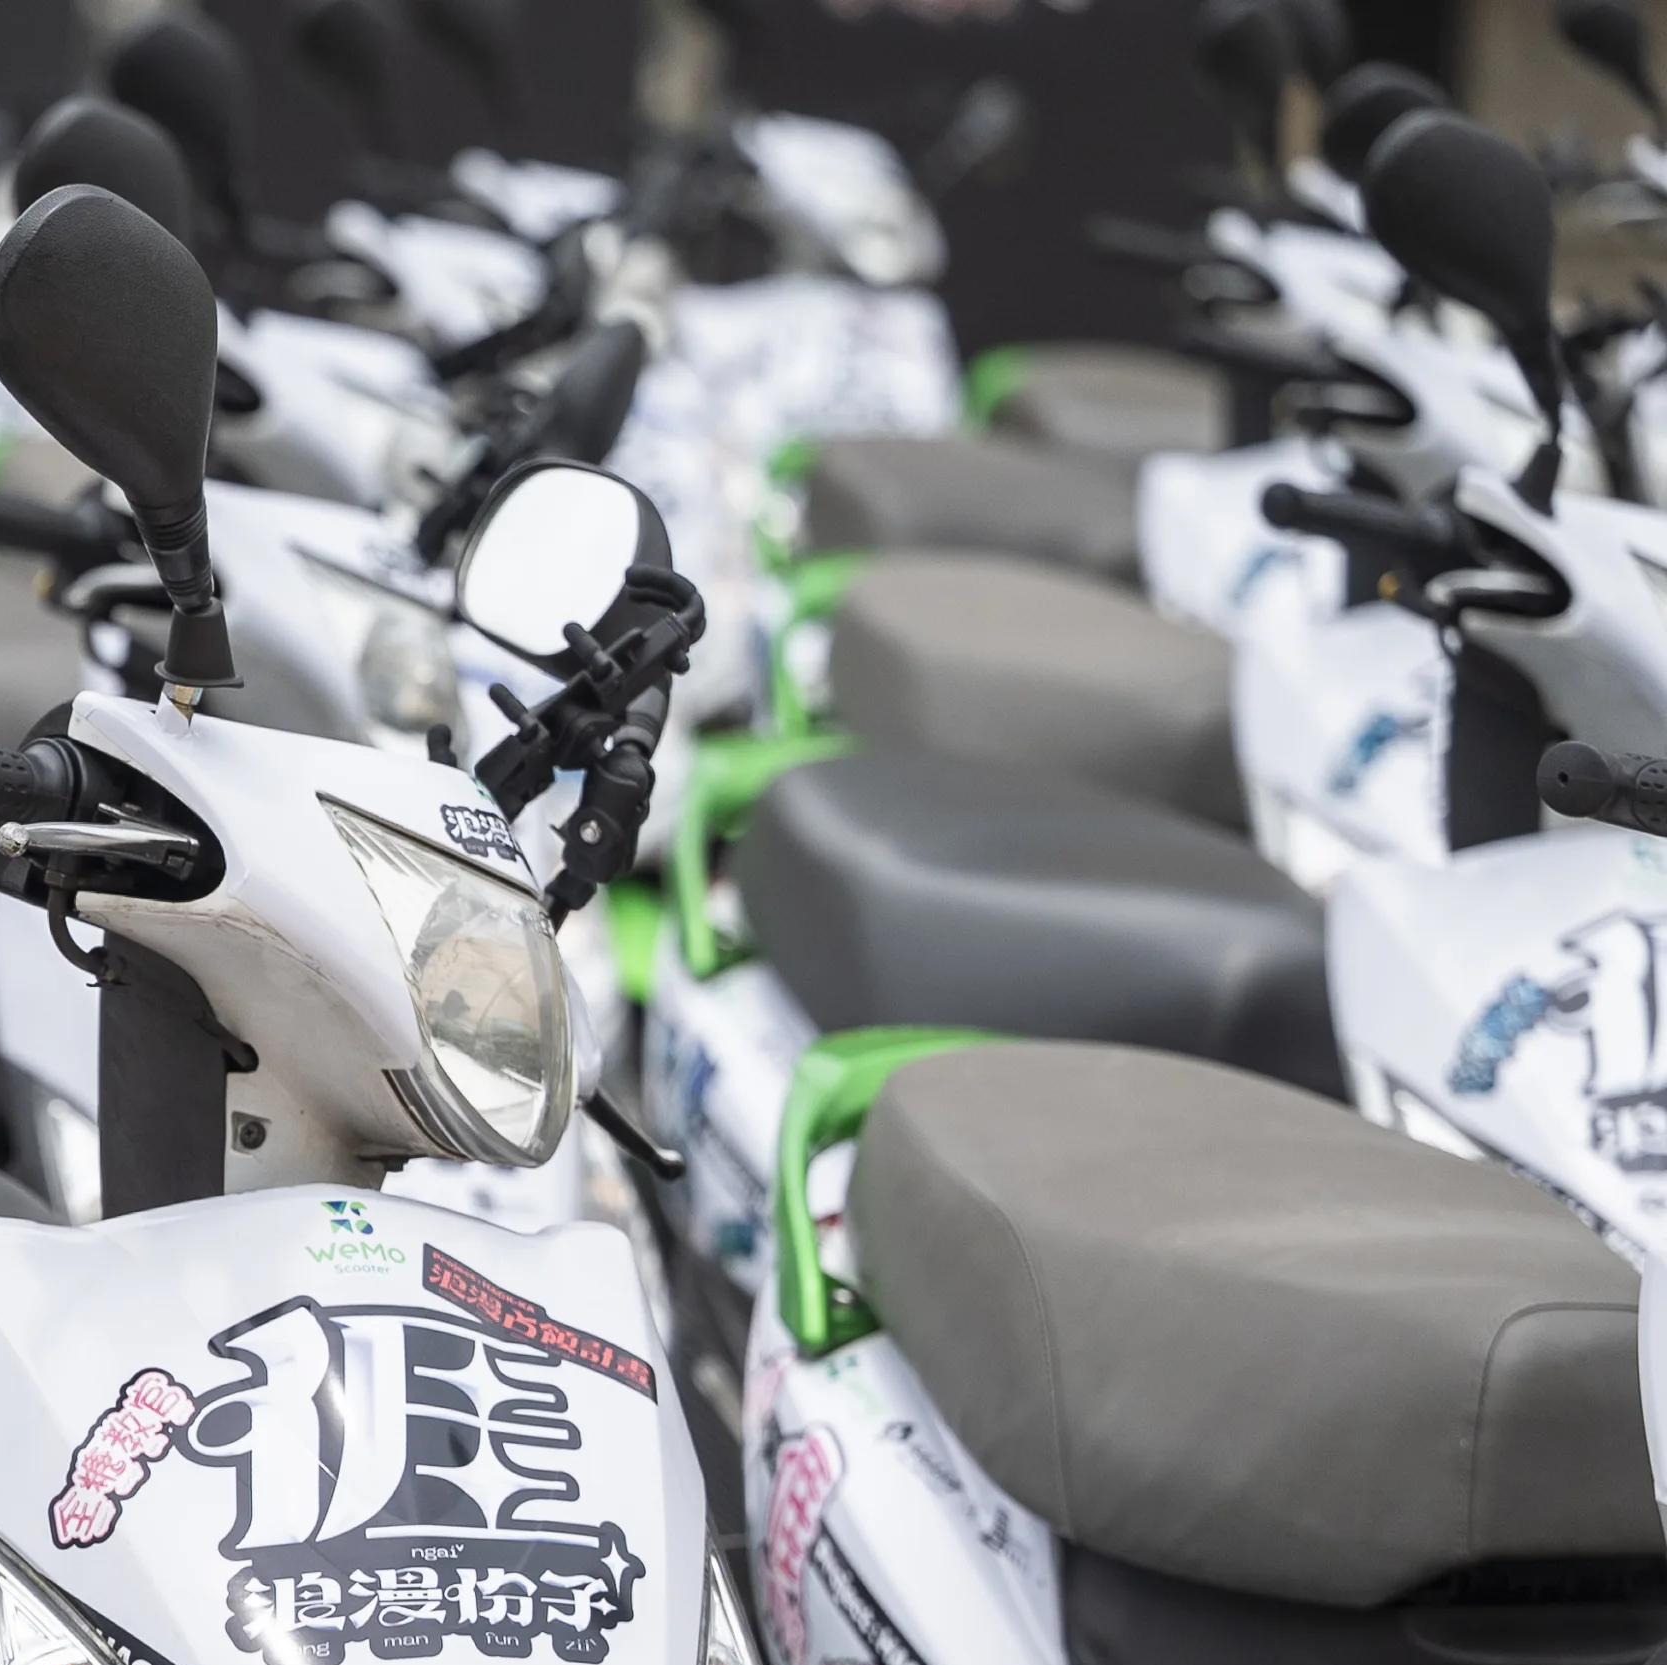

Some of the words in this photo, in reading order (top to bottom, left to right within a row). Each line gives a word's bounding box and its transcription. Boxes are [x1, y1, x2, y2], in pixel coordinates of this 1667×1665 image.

[304, 1240, 407, 1265] WeMo
[382, 1630, 430, 1649] man
[483, 1630, 521, 1649] fun
